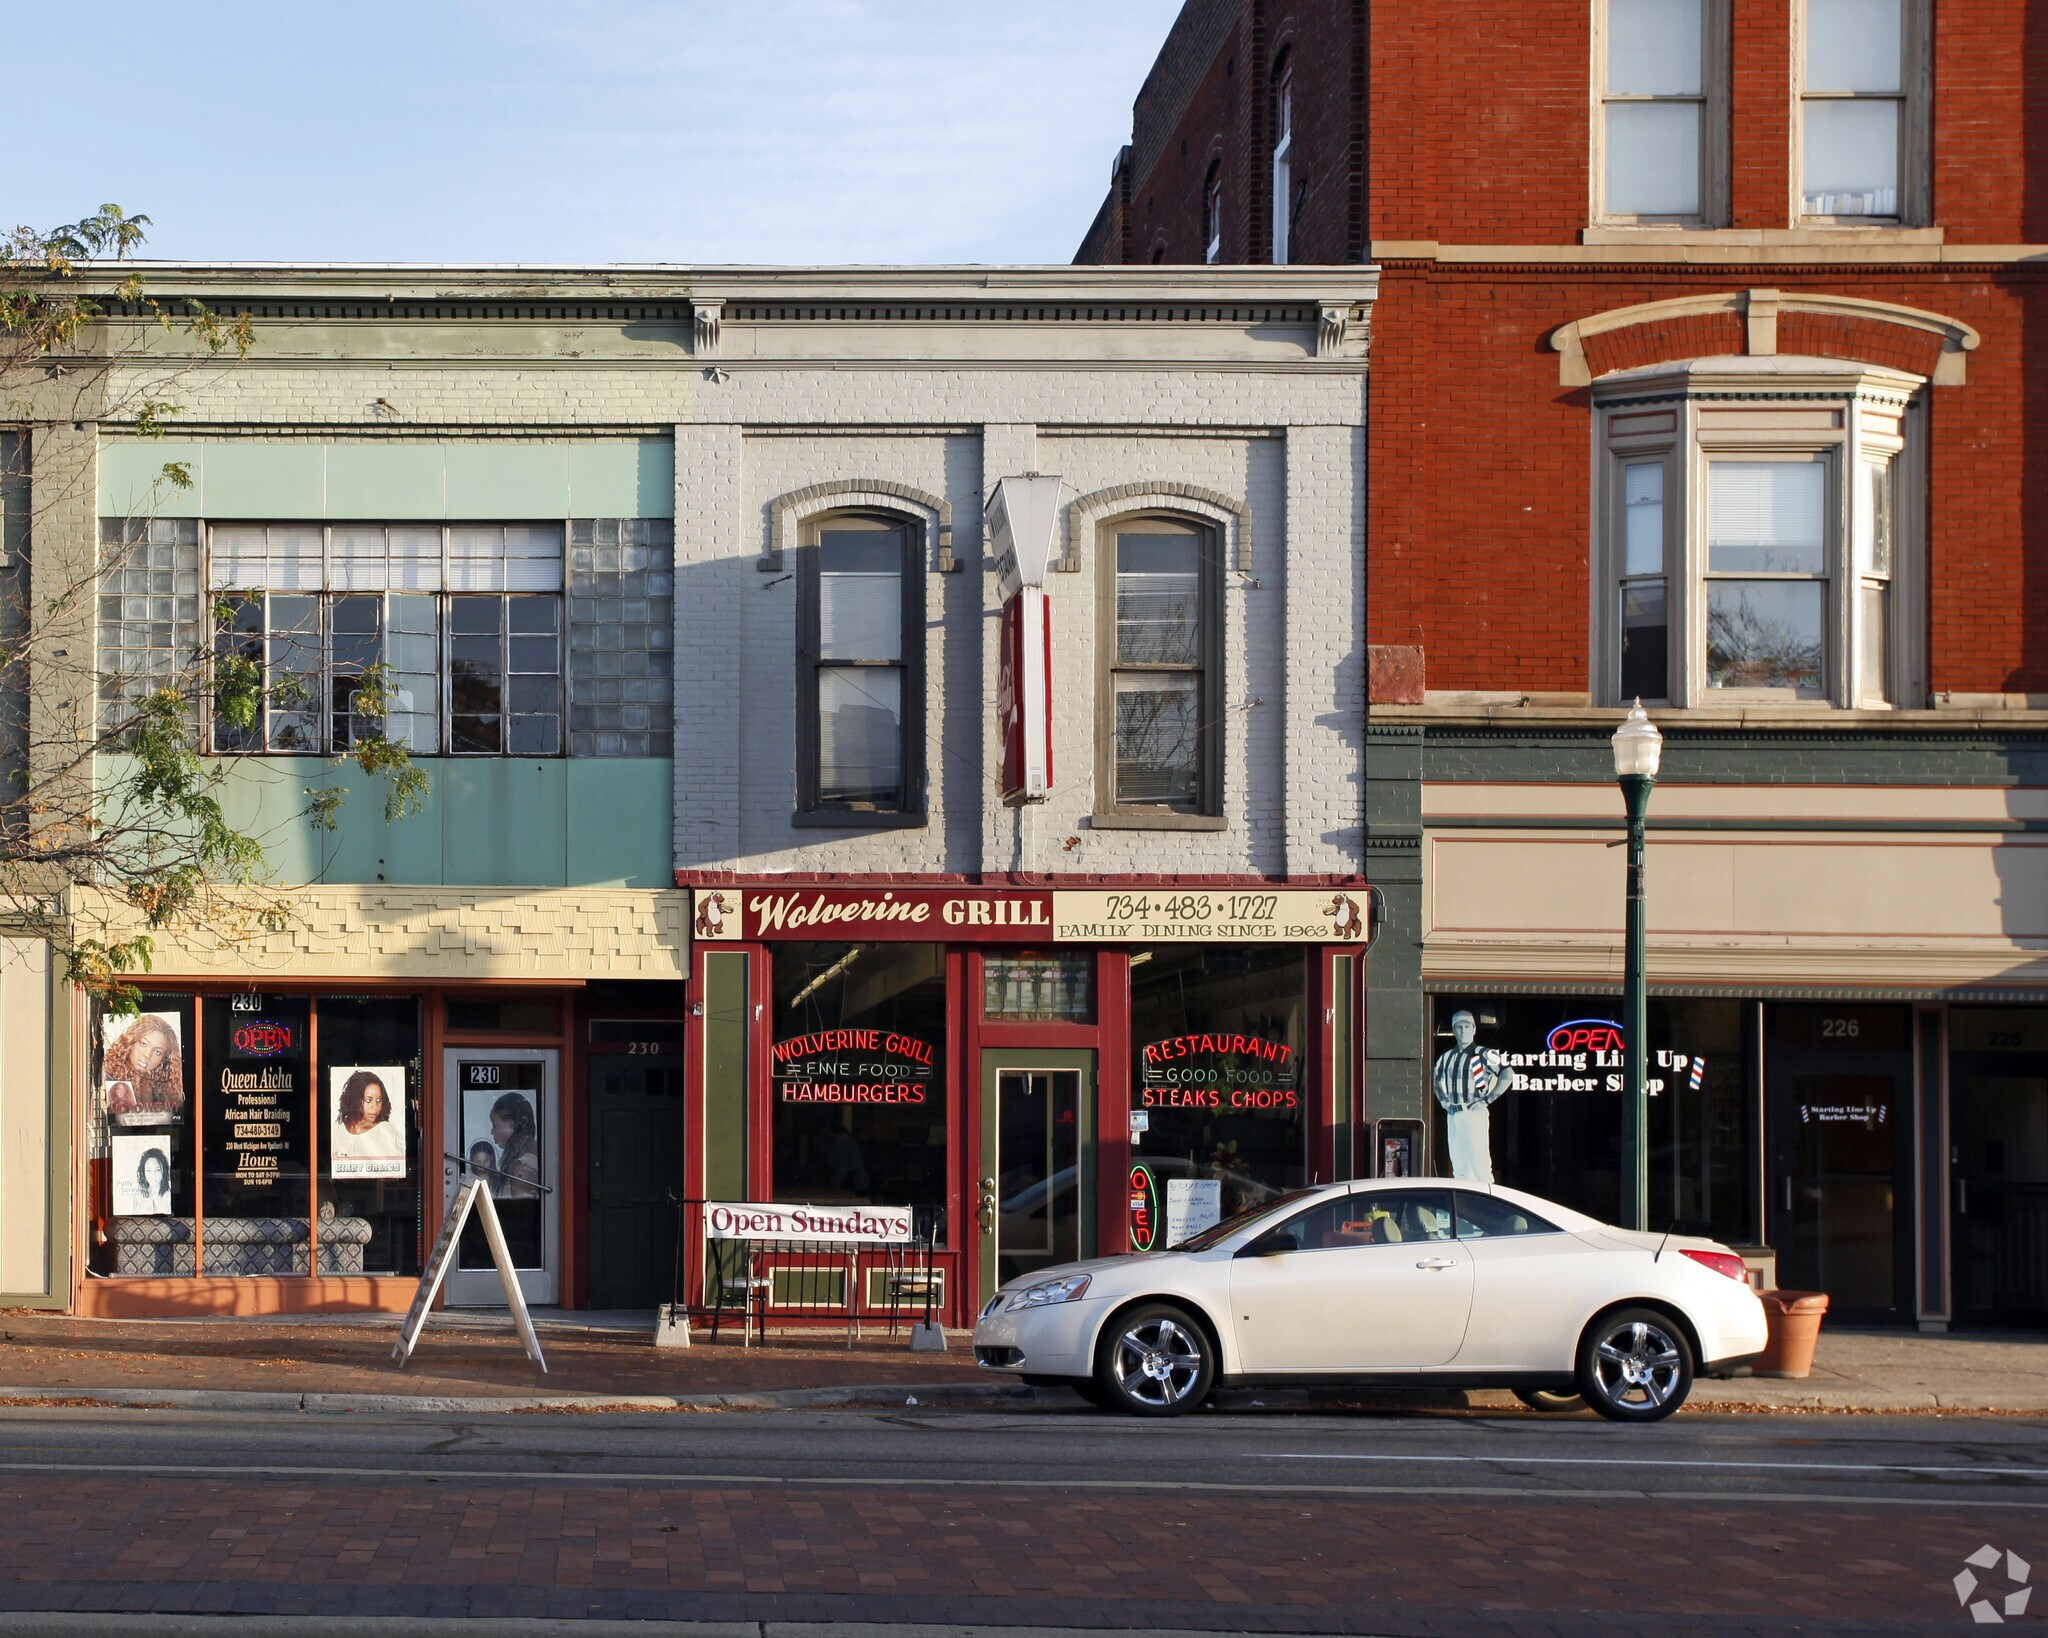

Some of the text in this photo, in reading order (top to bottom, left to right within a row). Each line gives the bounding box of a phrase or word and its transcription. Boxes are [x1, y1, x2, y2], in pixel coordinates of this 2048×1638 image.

[749, 892, 1050, 937] Wolverine GRILL
[1057, 923, 1329, 938] FAMILY DINING SINCE 1963
[234, 994, 260, 1010] 230
[1822, 1019, 1860, 1037] 226
[233, 1027, 292, 1049] OPEN
[1551, 1029, 1626, 1051] OPEN
[1987, 1031, 2022, 1047] 226
[627, 1041, 660, 1055] 230
[773, 1029, 934, 1065] WOLVERINE GRILL
[1144, 1034, 1294, 1064] RESTAURANT
[1486, 1050, 1587, 1071] Starting
[1656, 1050, 1688, 1072] Up
[472, 1067, 498, 1083] 230
[858, 1063, 911, 1077] FOOD
[1166, 1068, 1273, 1083] GOOD FOOD
[221, 1066, 292, 1094] Queen Aicha
[1511, 1074, 1664, 1096] Barber Sp
[237, 1093, 277, 1105] Professional
[784, 1083, 925, 1102] HAMBURGERS
[1144, 1089, 1298, 1108] STEAKS CHOPS
[225, 1108, 290, 1122] African Hair Braiding
[1811, 1106, 1844, 1114] Starting
[1866, 1106, 1877, 1114] Up
[1850, 1114, 1870, 1122] Shop
[236, 1125, 279, 1136] 734-480-3149
[238, 1152, 279, 1168] Hours
[243, 1178, 255, 1186] SUN
[711, 1207, 910, 1240] Open Sundays
